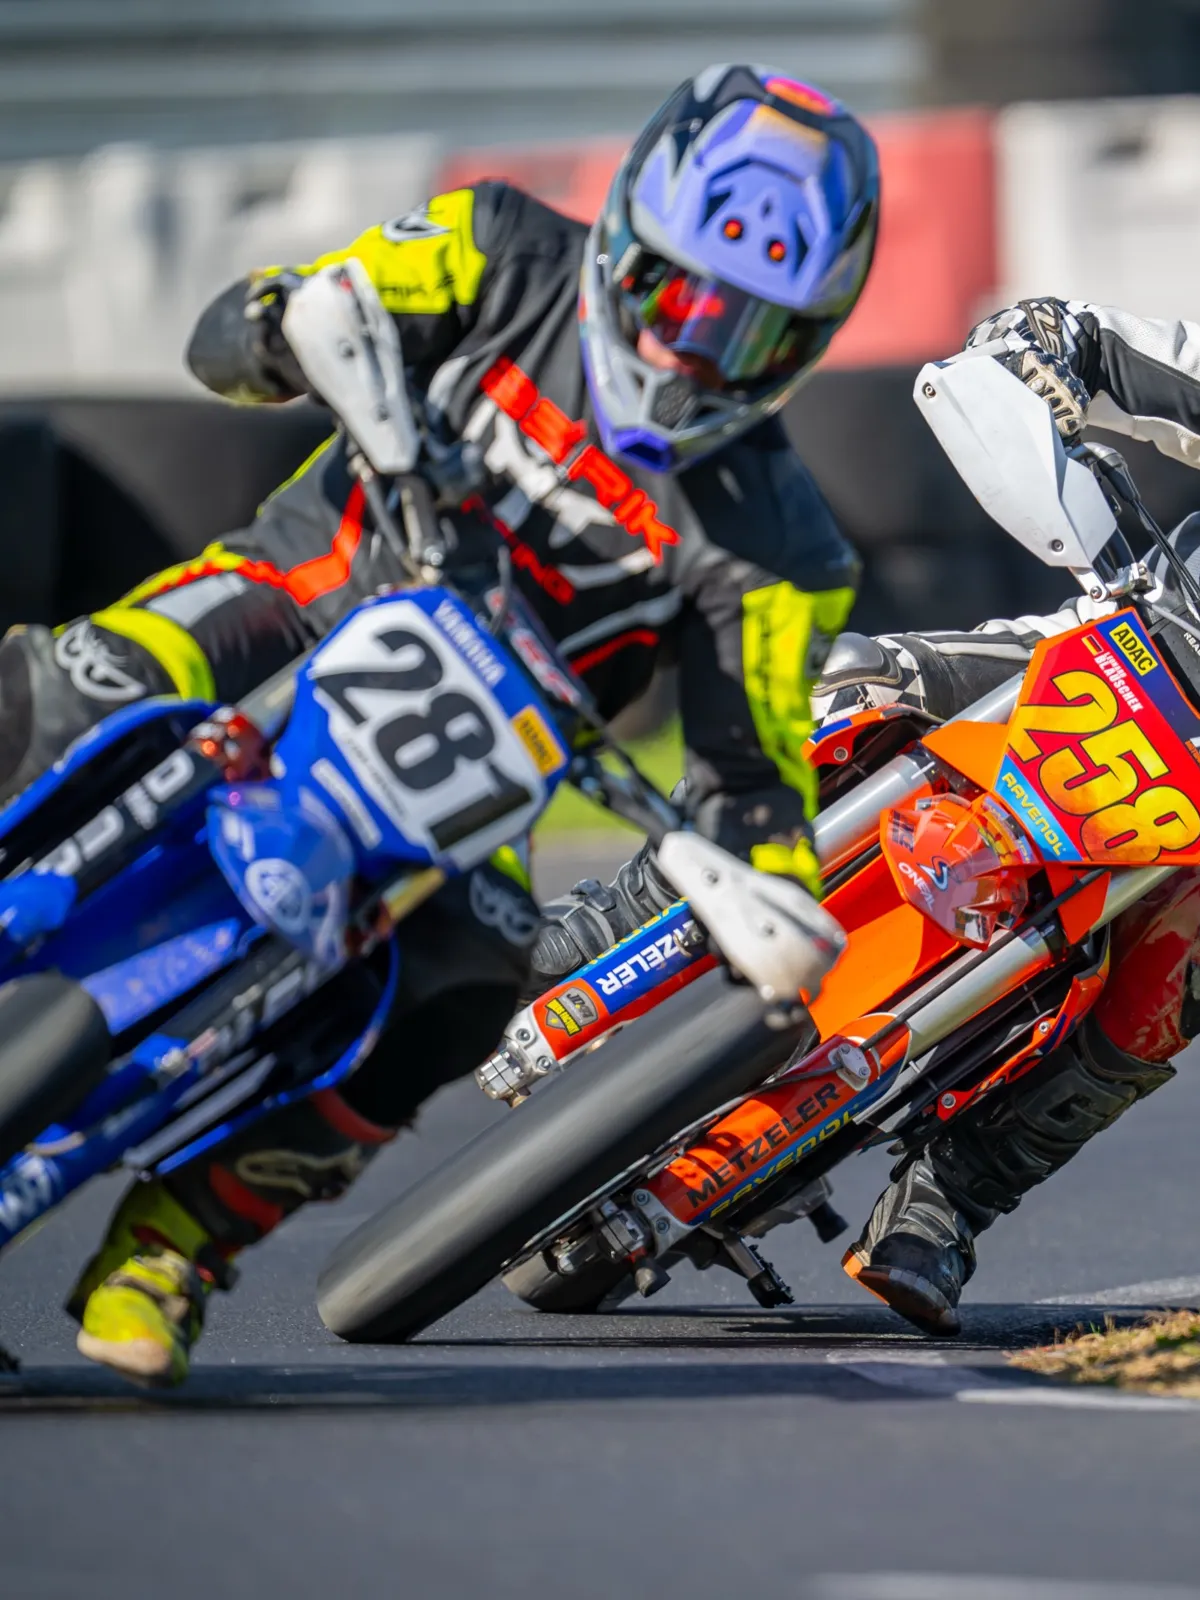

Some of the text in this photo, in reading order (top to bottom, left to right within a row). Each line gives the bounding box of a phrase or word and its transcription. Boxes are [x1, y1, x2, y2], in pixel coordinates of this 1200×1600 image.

[1094, 654, 1144, 713] BLAUSCHEK
[1114, 628, 1153, 671] ADAC
[316, 630, 533, 851] 281
[1002, 772, 1064, 856] RAVENOL
[898, 862, 935, 912] ONEAL
[686, 1082, 841, 1208] METZELER
